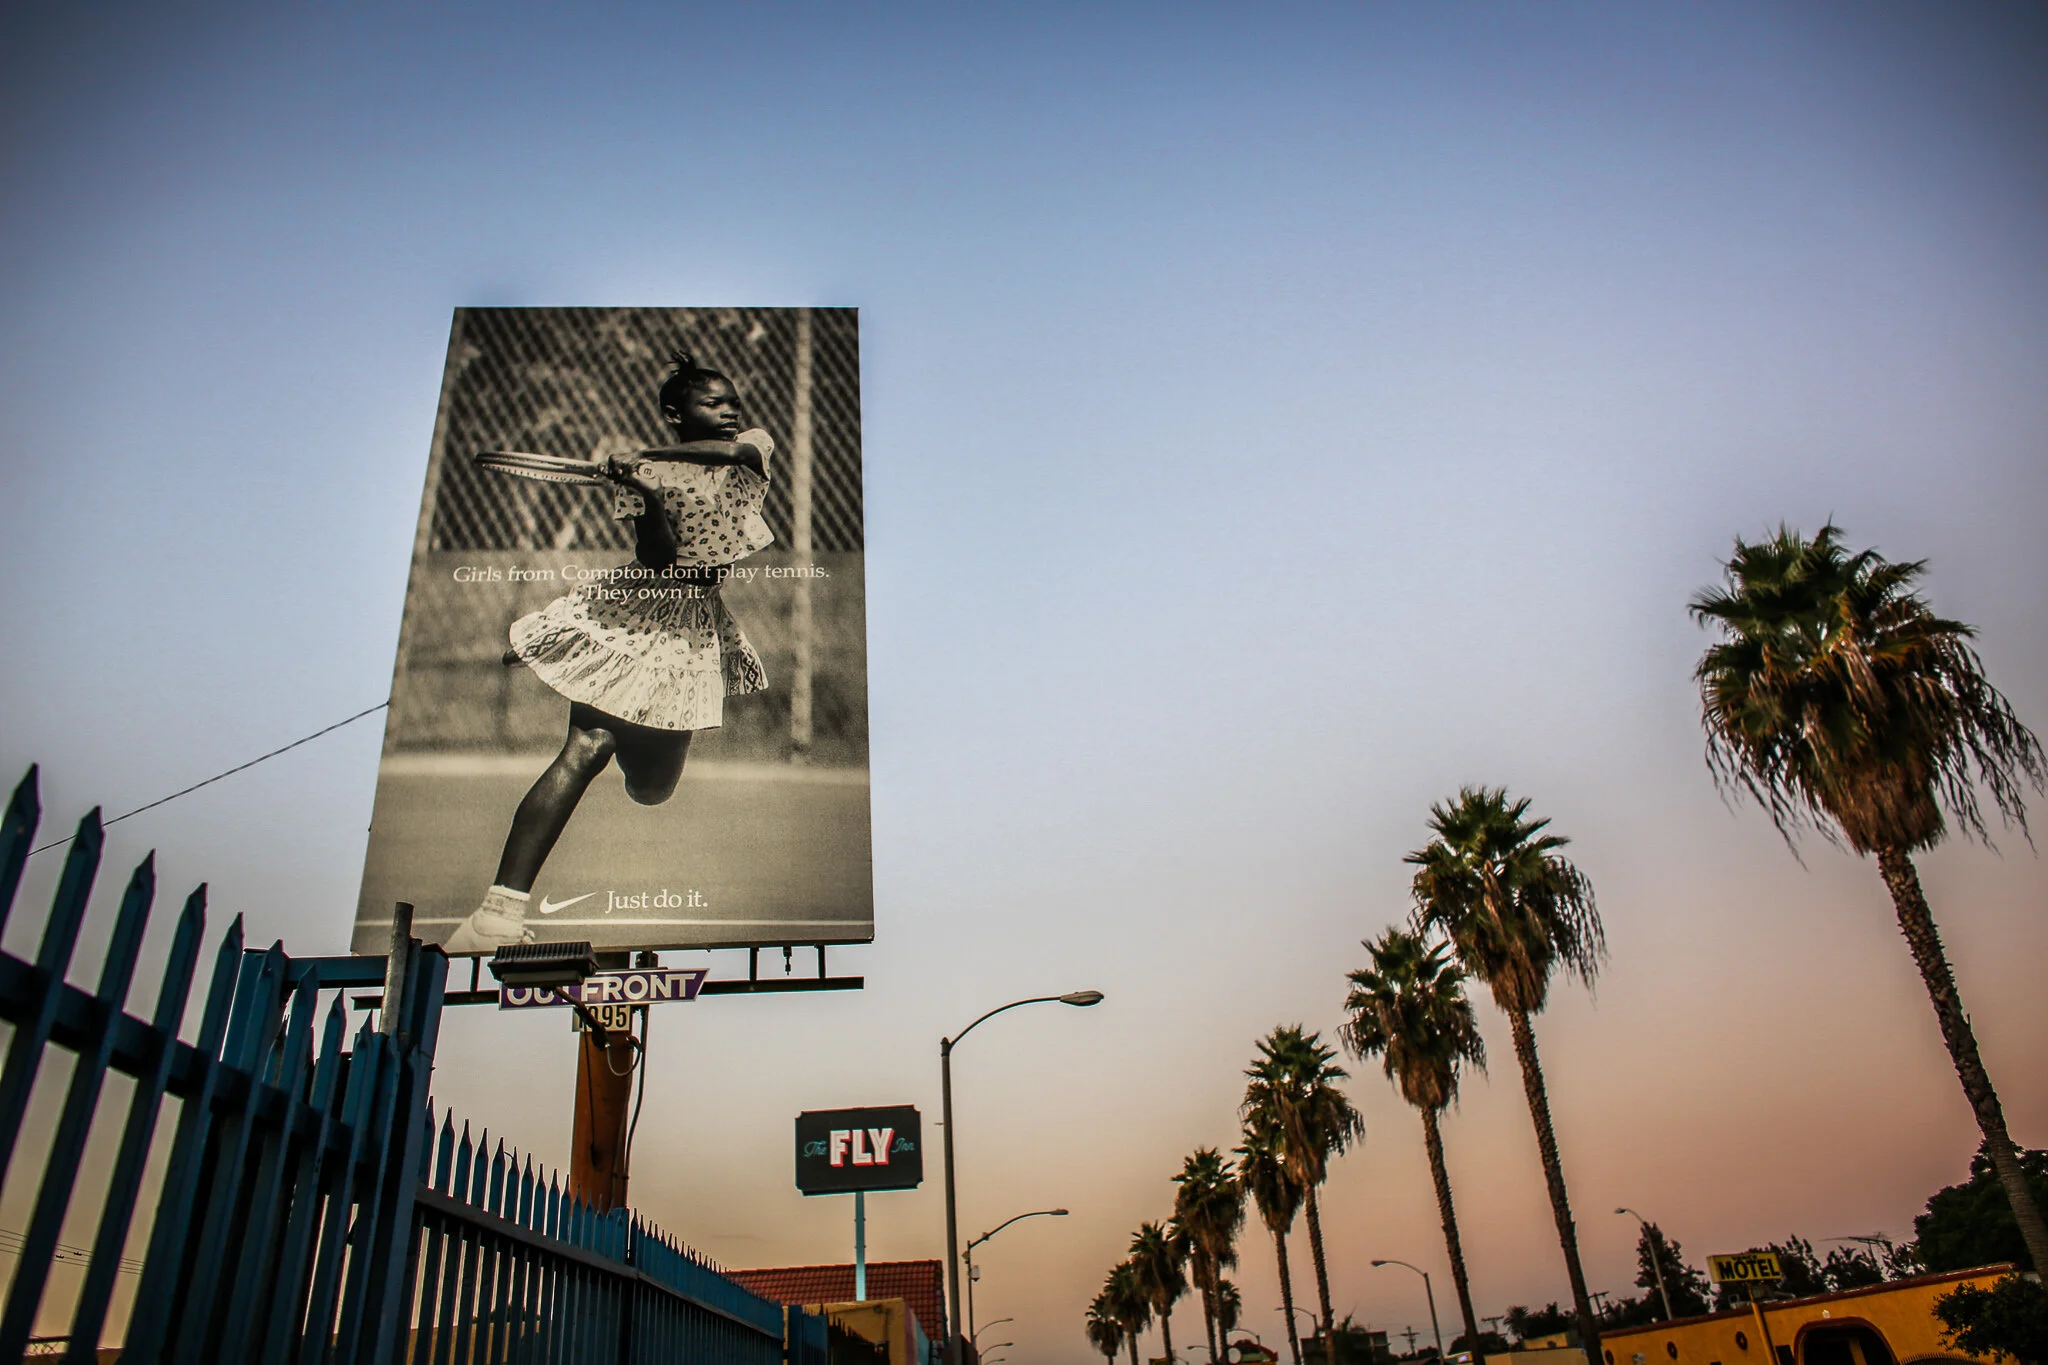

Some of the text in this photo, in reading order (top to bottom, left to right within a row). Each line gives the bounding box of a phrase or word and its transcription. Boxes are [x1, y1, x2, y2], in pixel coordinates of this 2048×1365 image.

[453, 564, 830, 585] Girls from Compton don't play tennis.
[585, 584, 705, 605] They own it.
[605, 889, 708, 914] Just do it.
[803, 1128, 915, 1167] The FLY Inn
[1717, 1258, 1780, 1280] MOTEL
